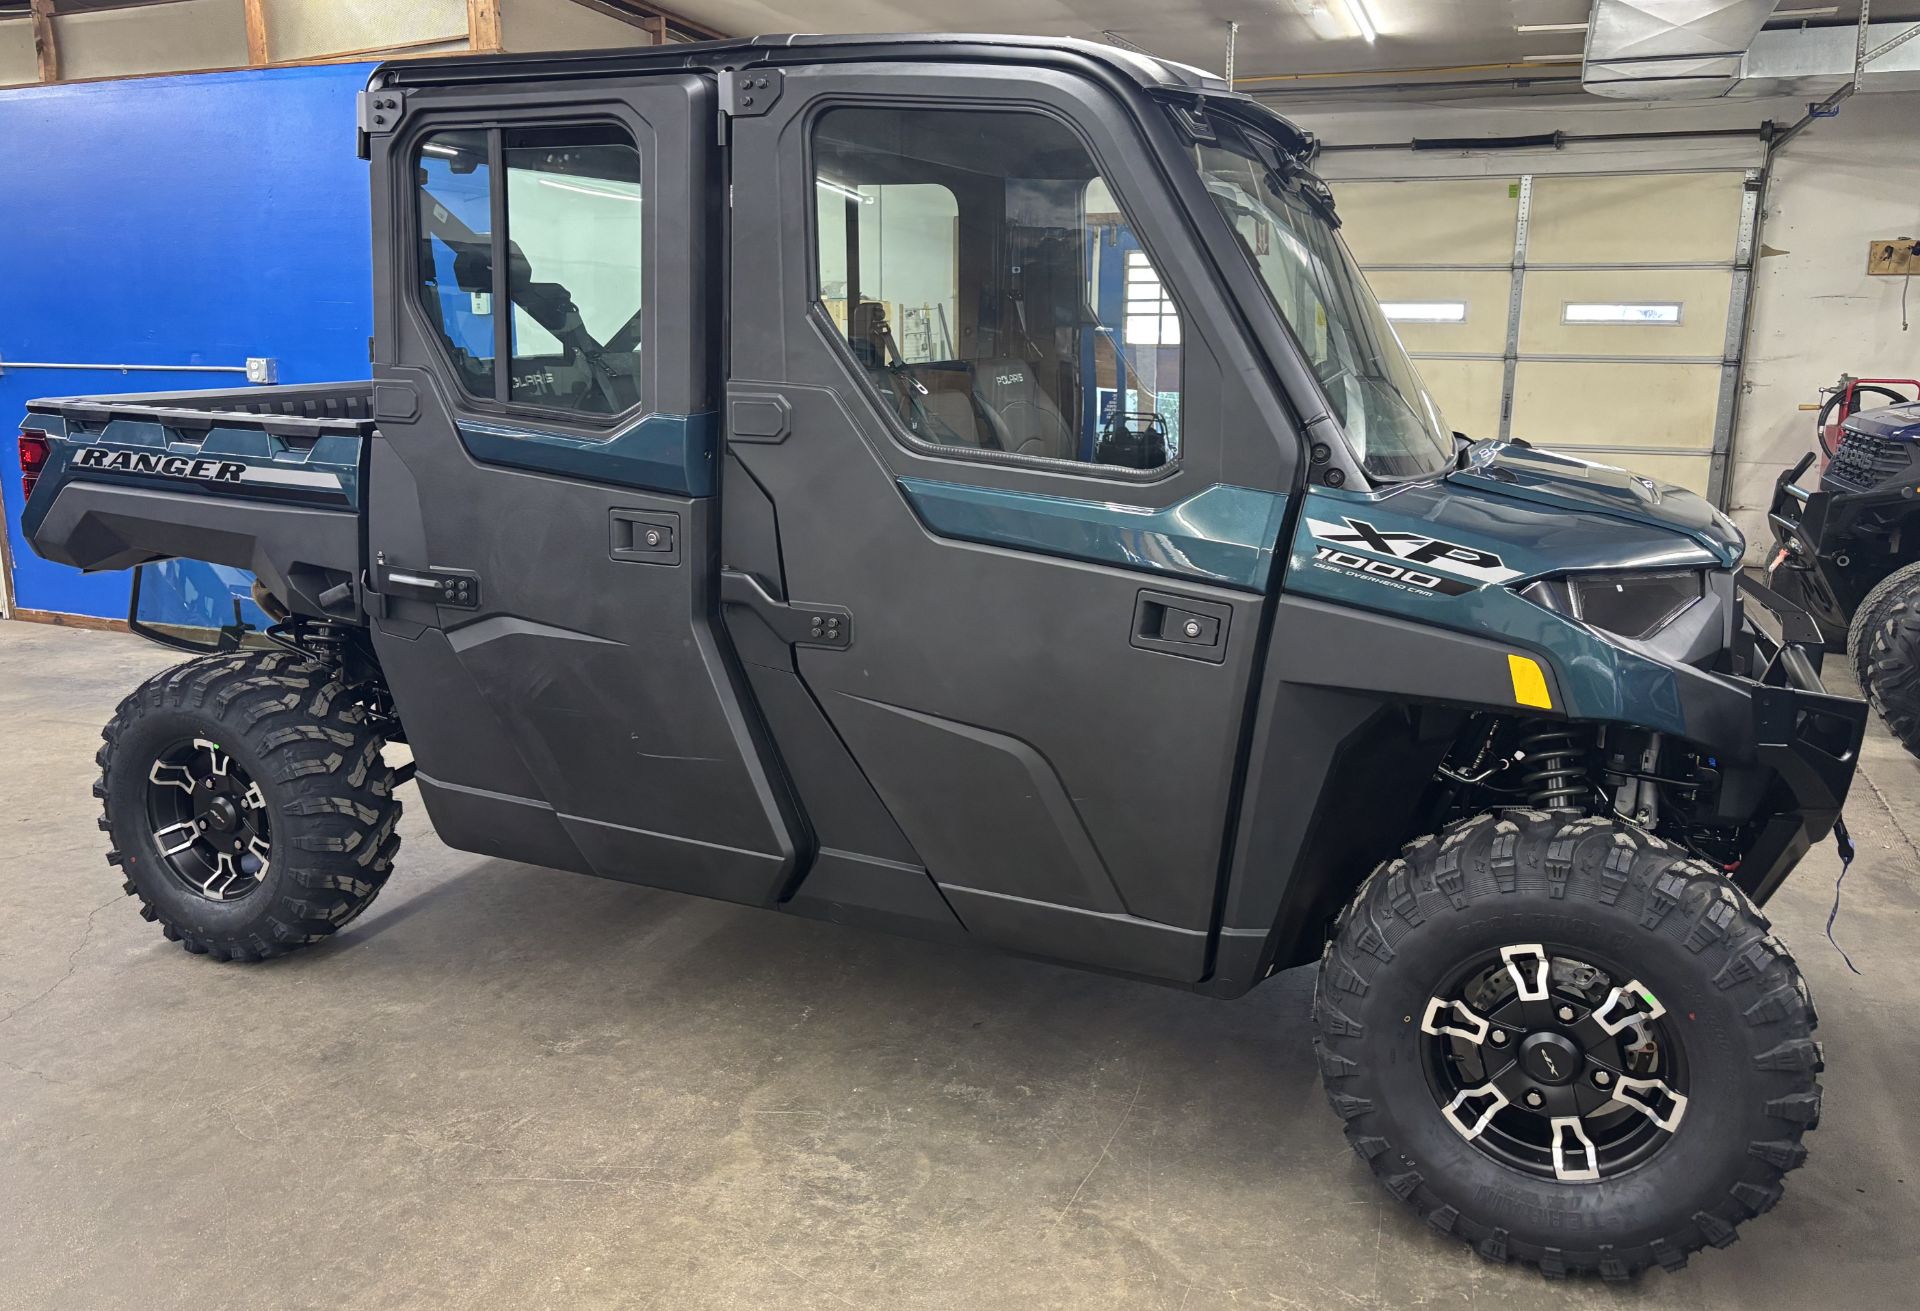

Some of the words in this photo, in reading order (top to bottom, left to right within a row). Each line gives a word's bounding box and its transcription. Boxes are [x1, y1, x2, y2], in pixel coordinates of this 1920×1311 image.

[512, 373, 554, 389] OLARIS
[995, 373, 1024, 387] POLARIS
[79, 448, 247, 483] RANGER
[1312, 516, 1506, 569] XP
[1312, 547, 1442, 588] 1000
[1312, 562, 1343, 575] DUAL
[1345, 570, 1406, 590] OVERHEAD
[1407, 587, 1434, 598] CAM
